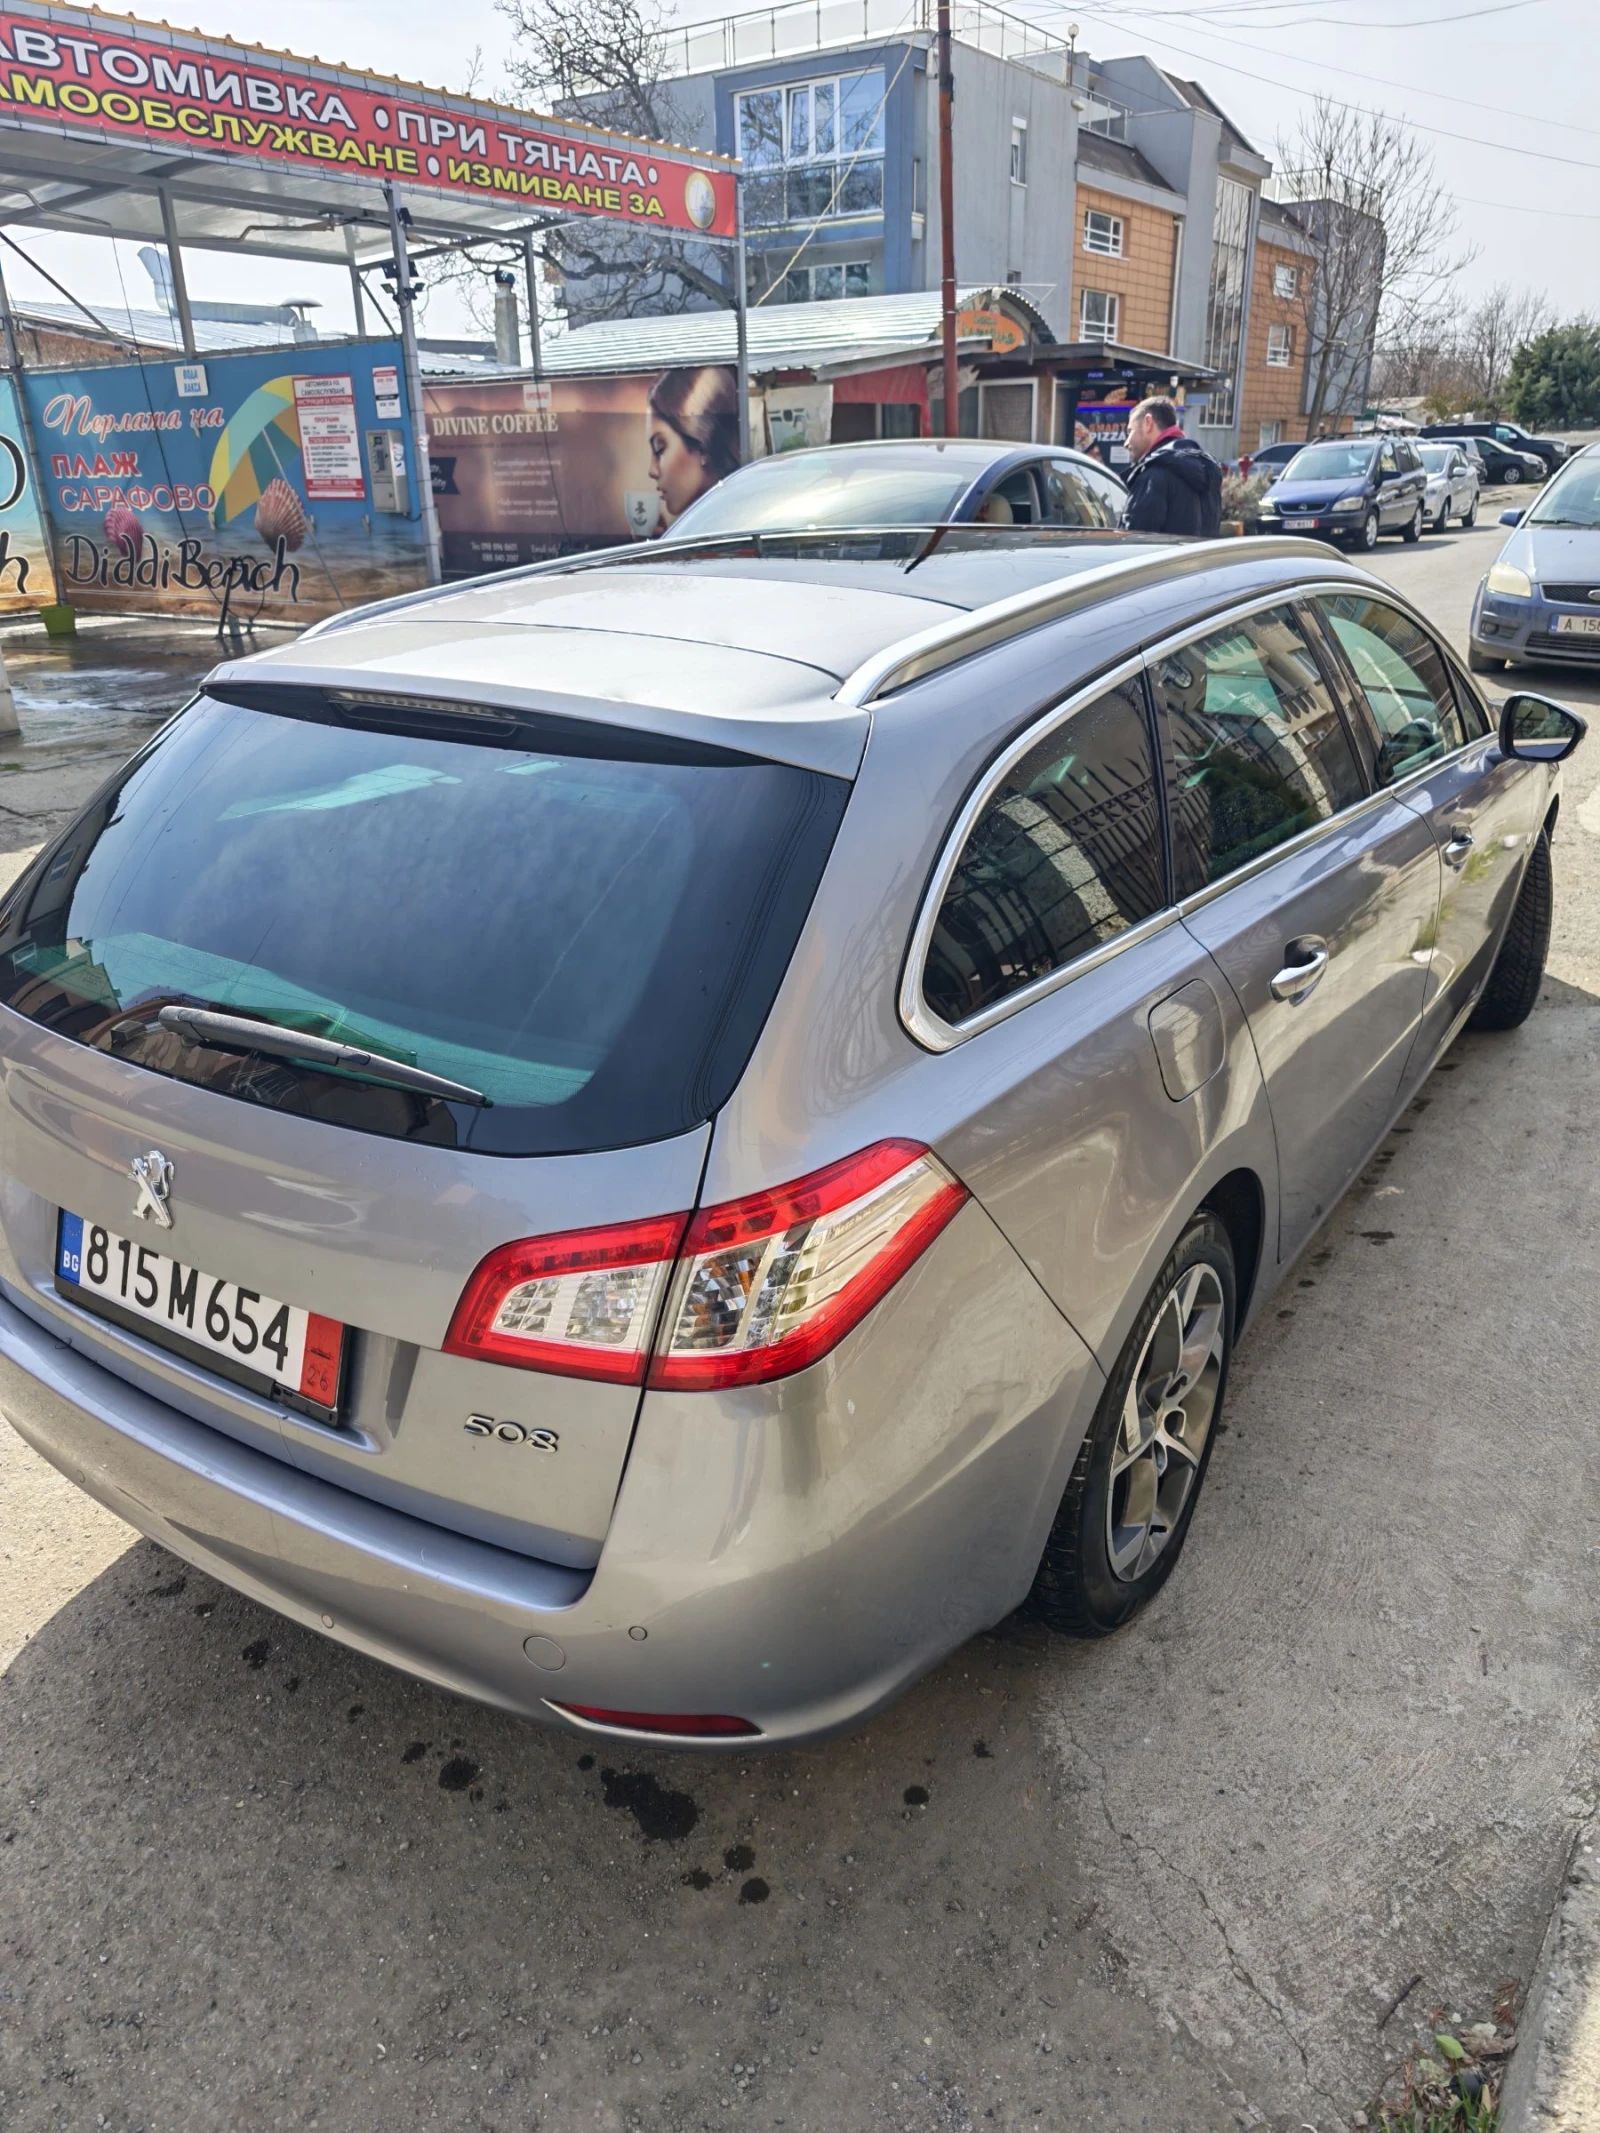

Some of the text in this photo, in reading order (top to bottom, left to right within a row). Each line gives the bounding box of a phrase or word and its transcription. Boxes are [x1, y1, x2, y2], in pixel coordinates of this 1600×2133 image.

[397, 109, 488, 156] ПРИ
[498, 133, 646, 188] ТЯНАТА
[448, 157, 622, 212] ИЗМИВАНЕ
[628, 194, 665, 218] ЗА
[43, 394, 225, 443] Перлата на
[432, 412, 559, 436] DIVINE COFFEE
[1089, 423, 1127, 432] SMART
[1089, 431, 1127, 441] PIZZA
[51, 452, 142, 478] ПЛАЖ
[59, 483, 218, 511] САРАФОВО
[63, 1250, 79, 1273] BG
[464, 1412, 560, 1454] 508
